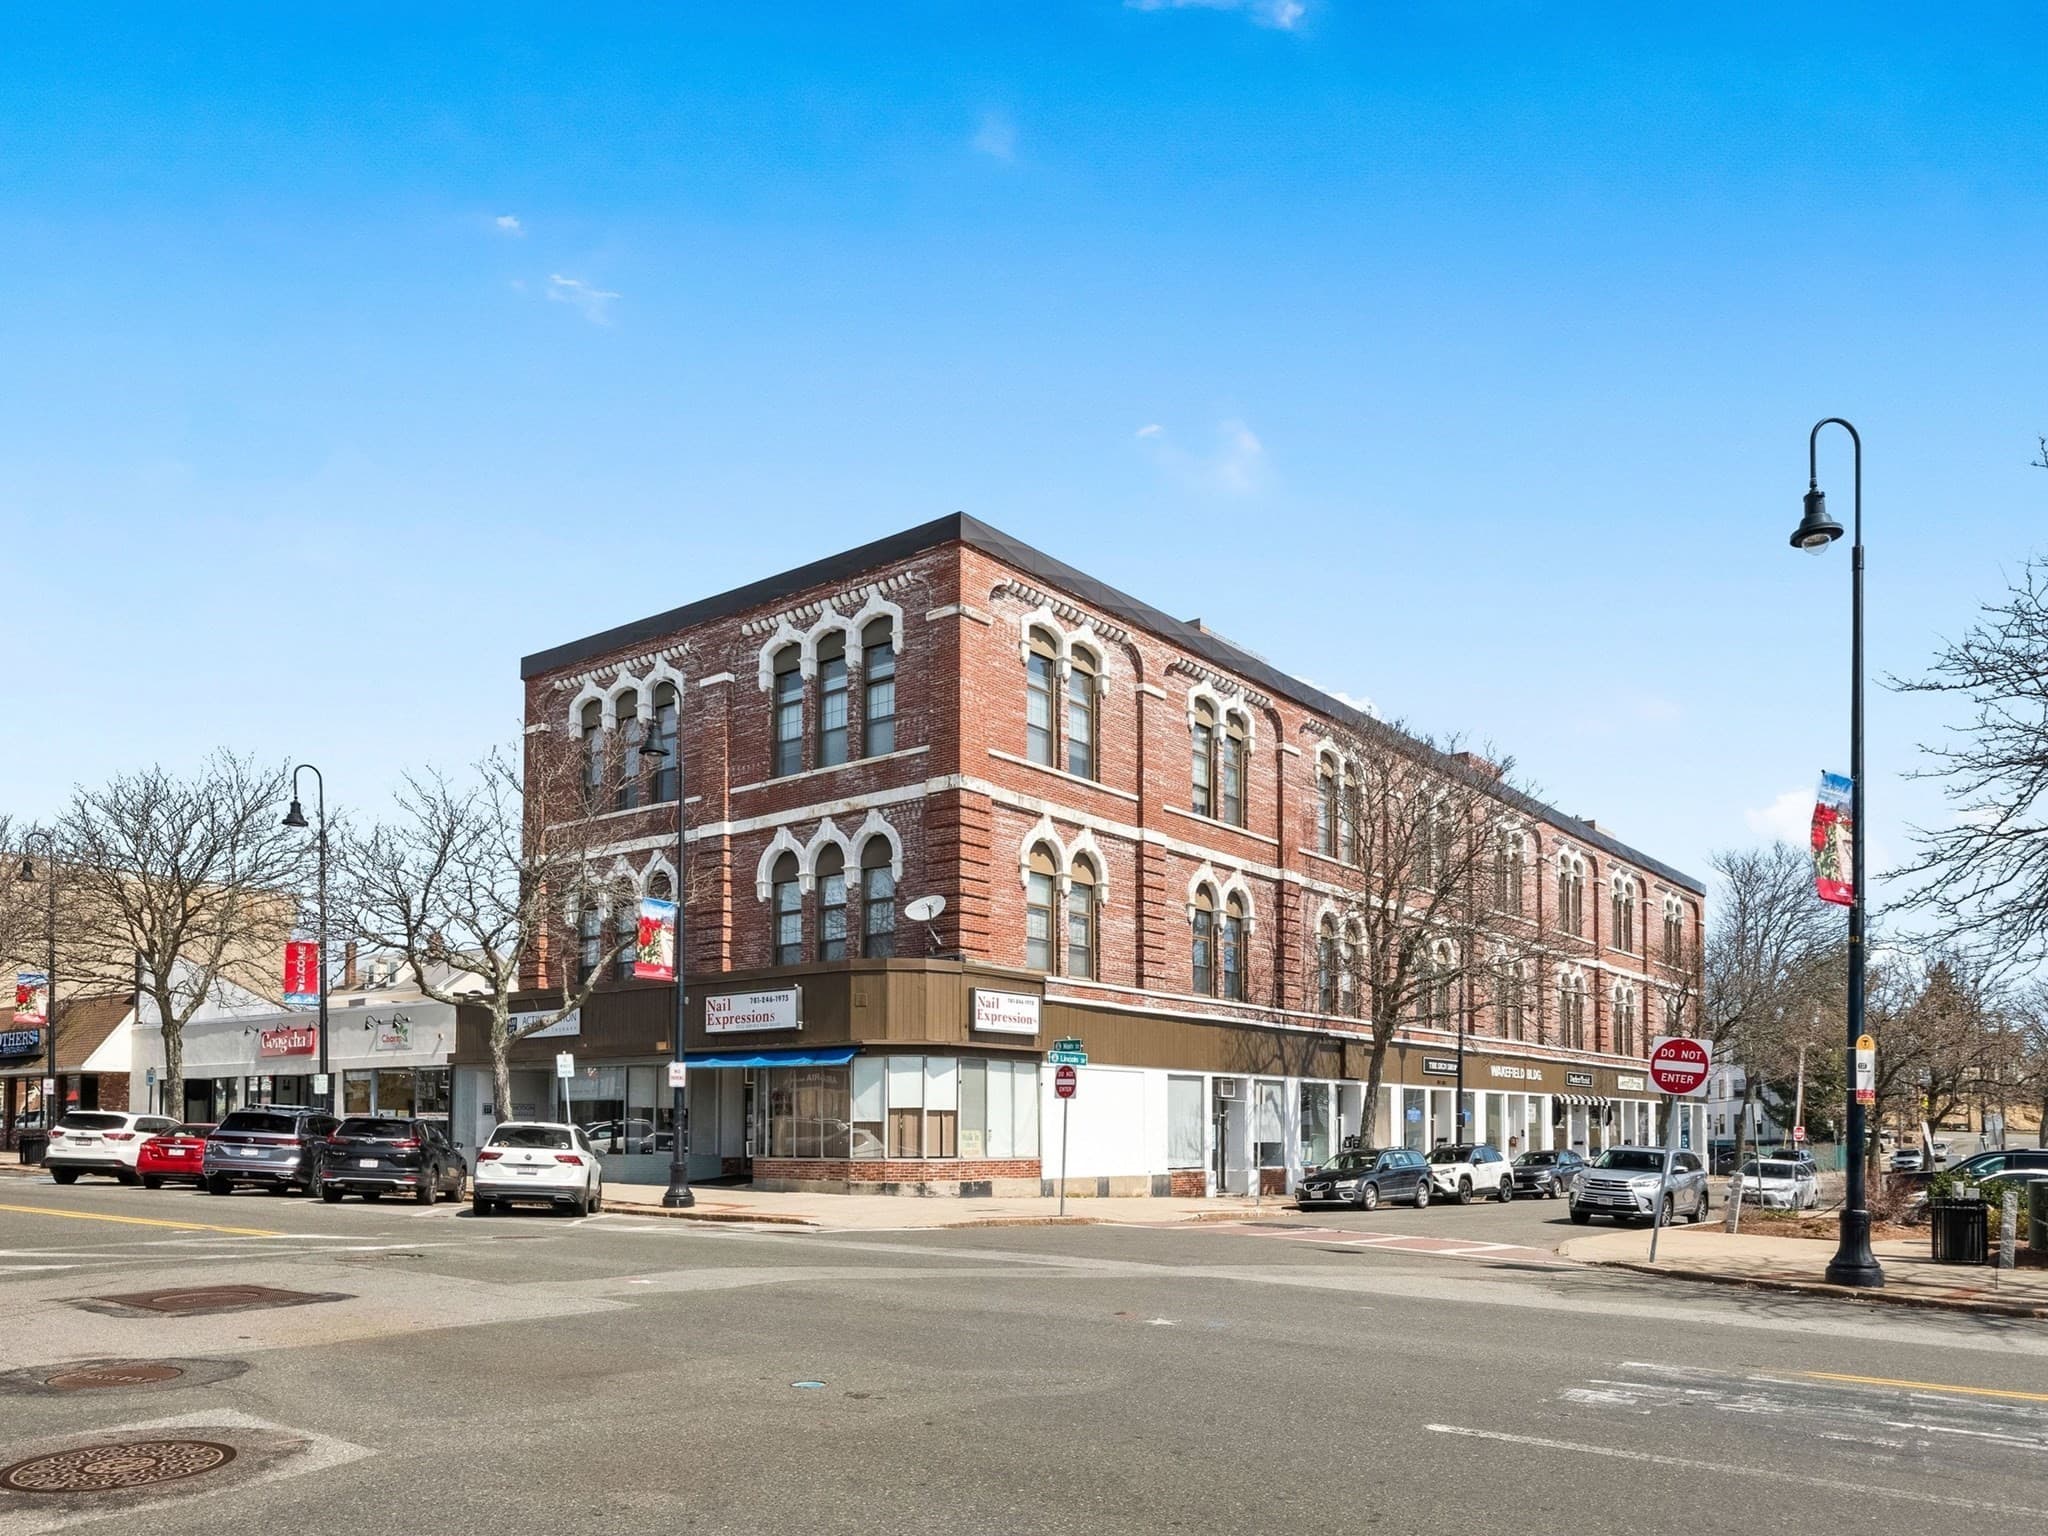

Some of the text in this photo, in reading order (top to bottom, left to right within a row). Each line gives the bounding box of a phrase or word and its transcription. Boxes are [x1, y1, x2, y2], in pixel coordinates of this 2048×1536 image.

[707, 998, 731, 1013] Nail
[977, 995, 1000, 1009] Nail
[706, 1009, 776, 1030] Expressions
[977, 1008, 1038, 1026] Expressions
[1661, 1048, 1703, 1060] DO NOT
[1490, 1065, 1525, 1079] WAKEFIELD
[1661, 1072, 1694, 1085] ENTER
